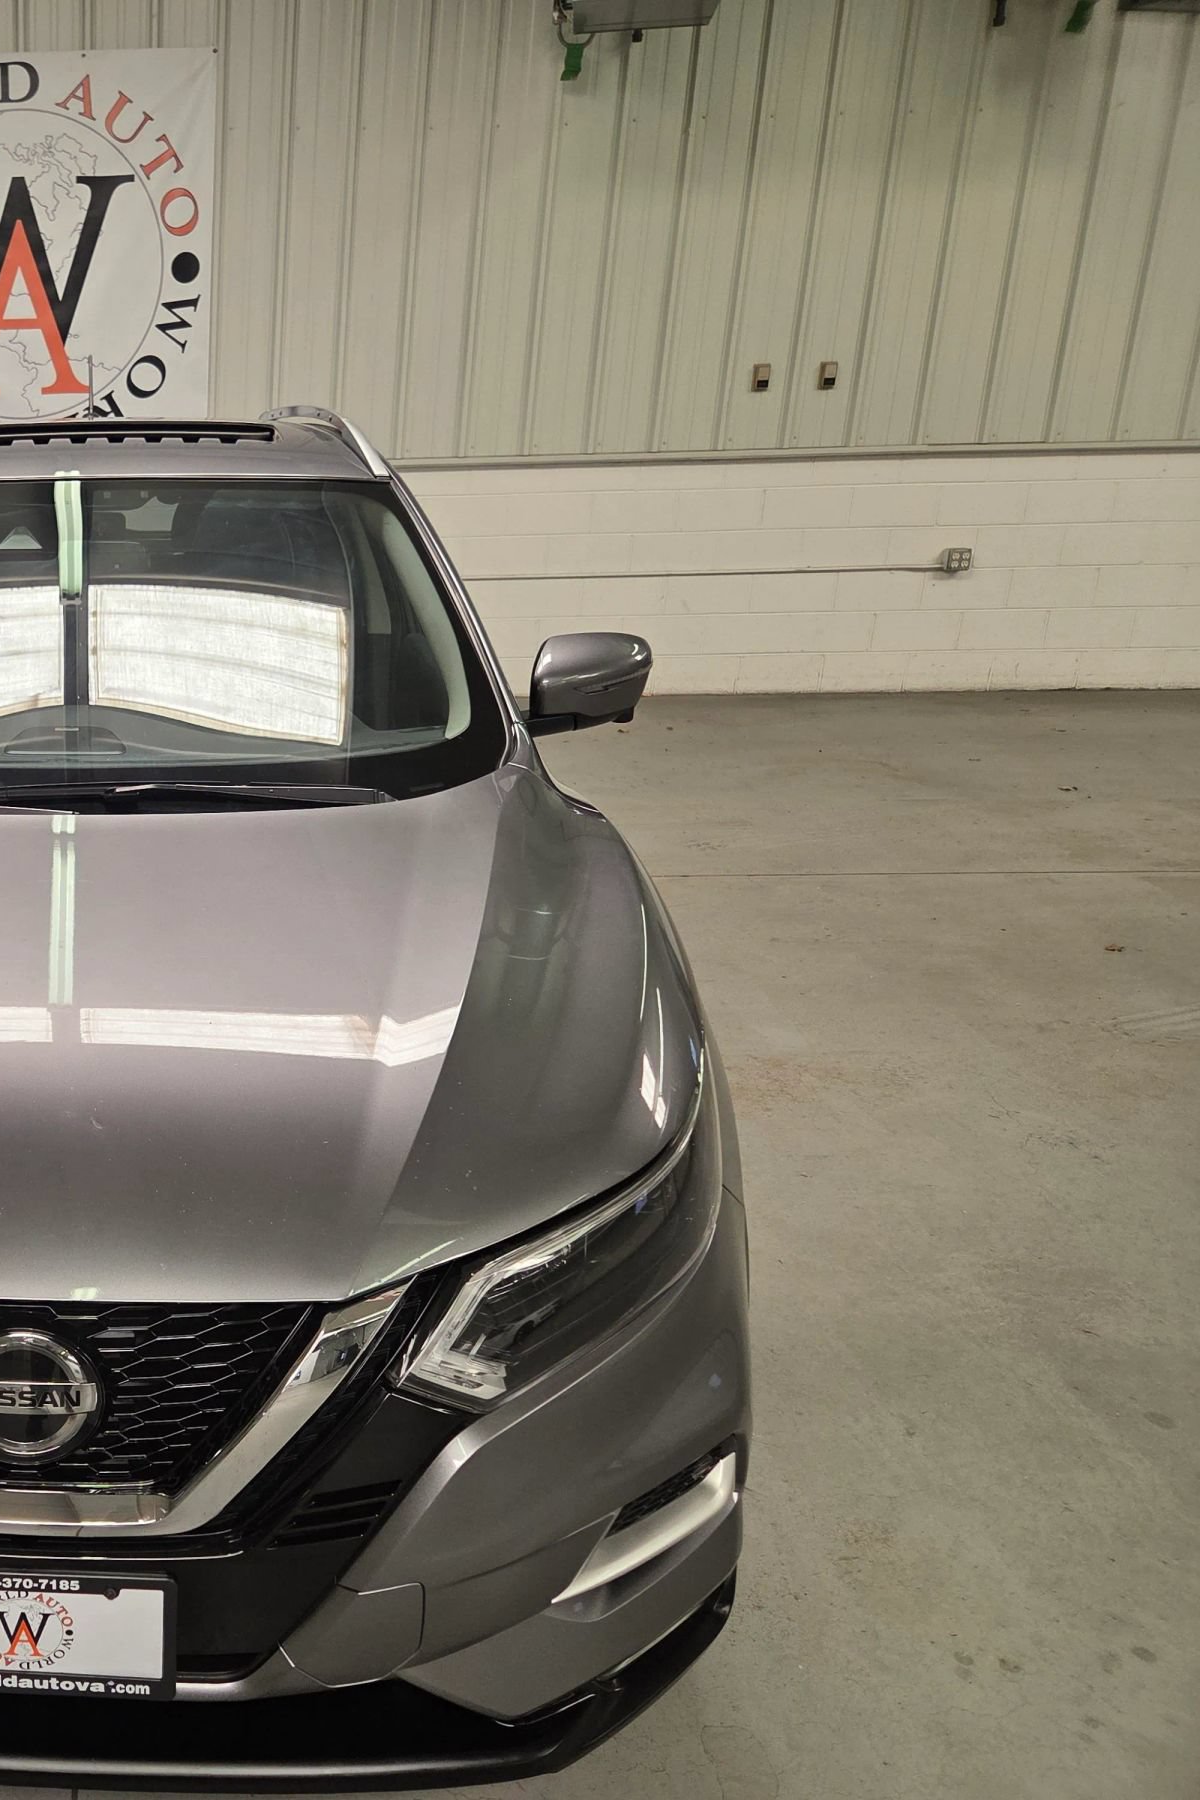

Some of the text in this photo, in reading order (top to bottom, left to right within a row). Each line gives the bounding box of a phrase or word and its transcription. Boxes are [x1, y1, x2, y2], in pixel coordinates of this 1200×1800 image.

[55, 74, 200, 237] AUTO
[34, 1593, 73, 1627] AUTO
[19, 1638, 74, 1670] WORLD
